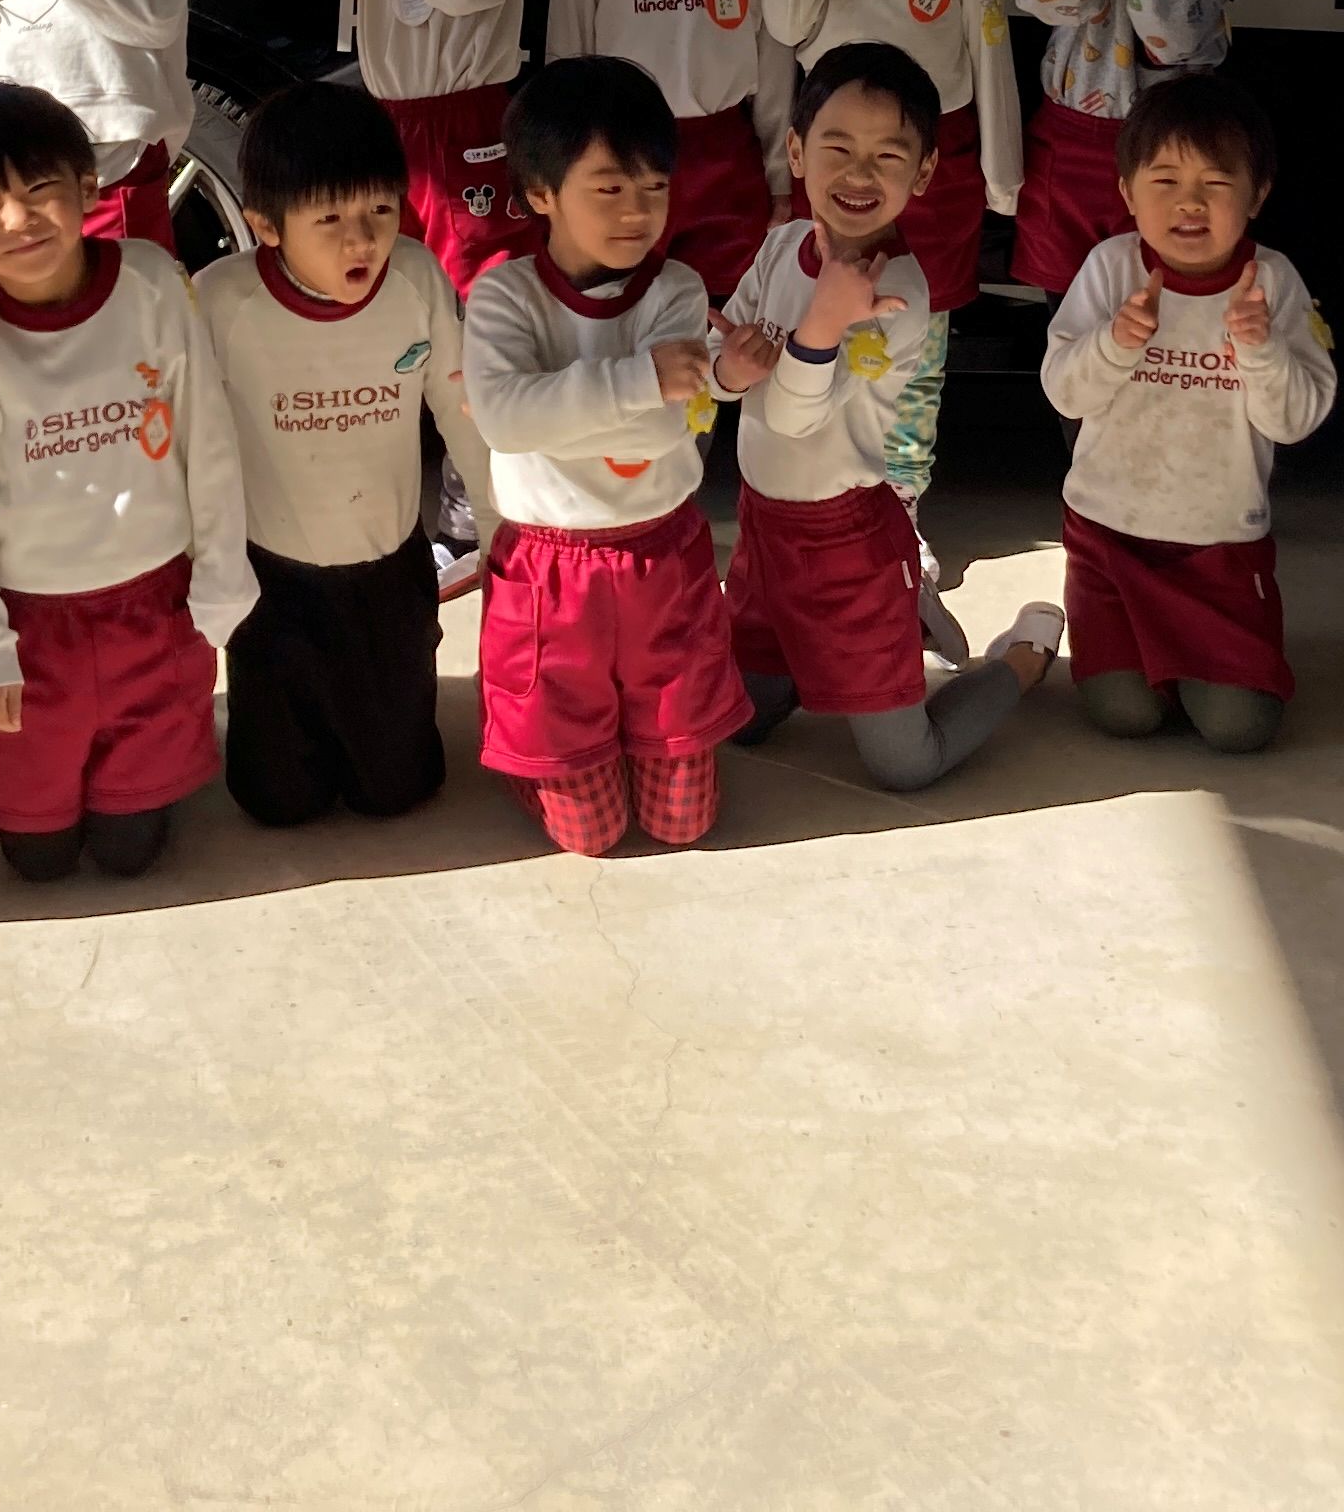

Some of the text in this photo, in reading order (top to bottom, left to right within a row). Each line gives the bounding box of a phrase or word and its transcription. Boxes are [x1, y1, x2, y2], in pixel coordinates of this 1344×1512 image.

[293, 384, 401, 410] SHION
[42, 399, 152, 436] SHION
[274, 408, 400, 432] kindergarten
[25, 424, 140, 463] kindergarte
